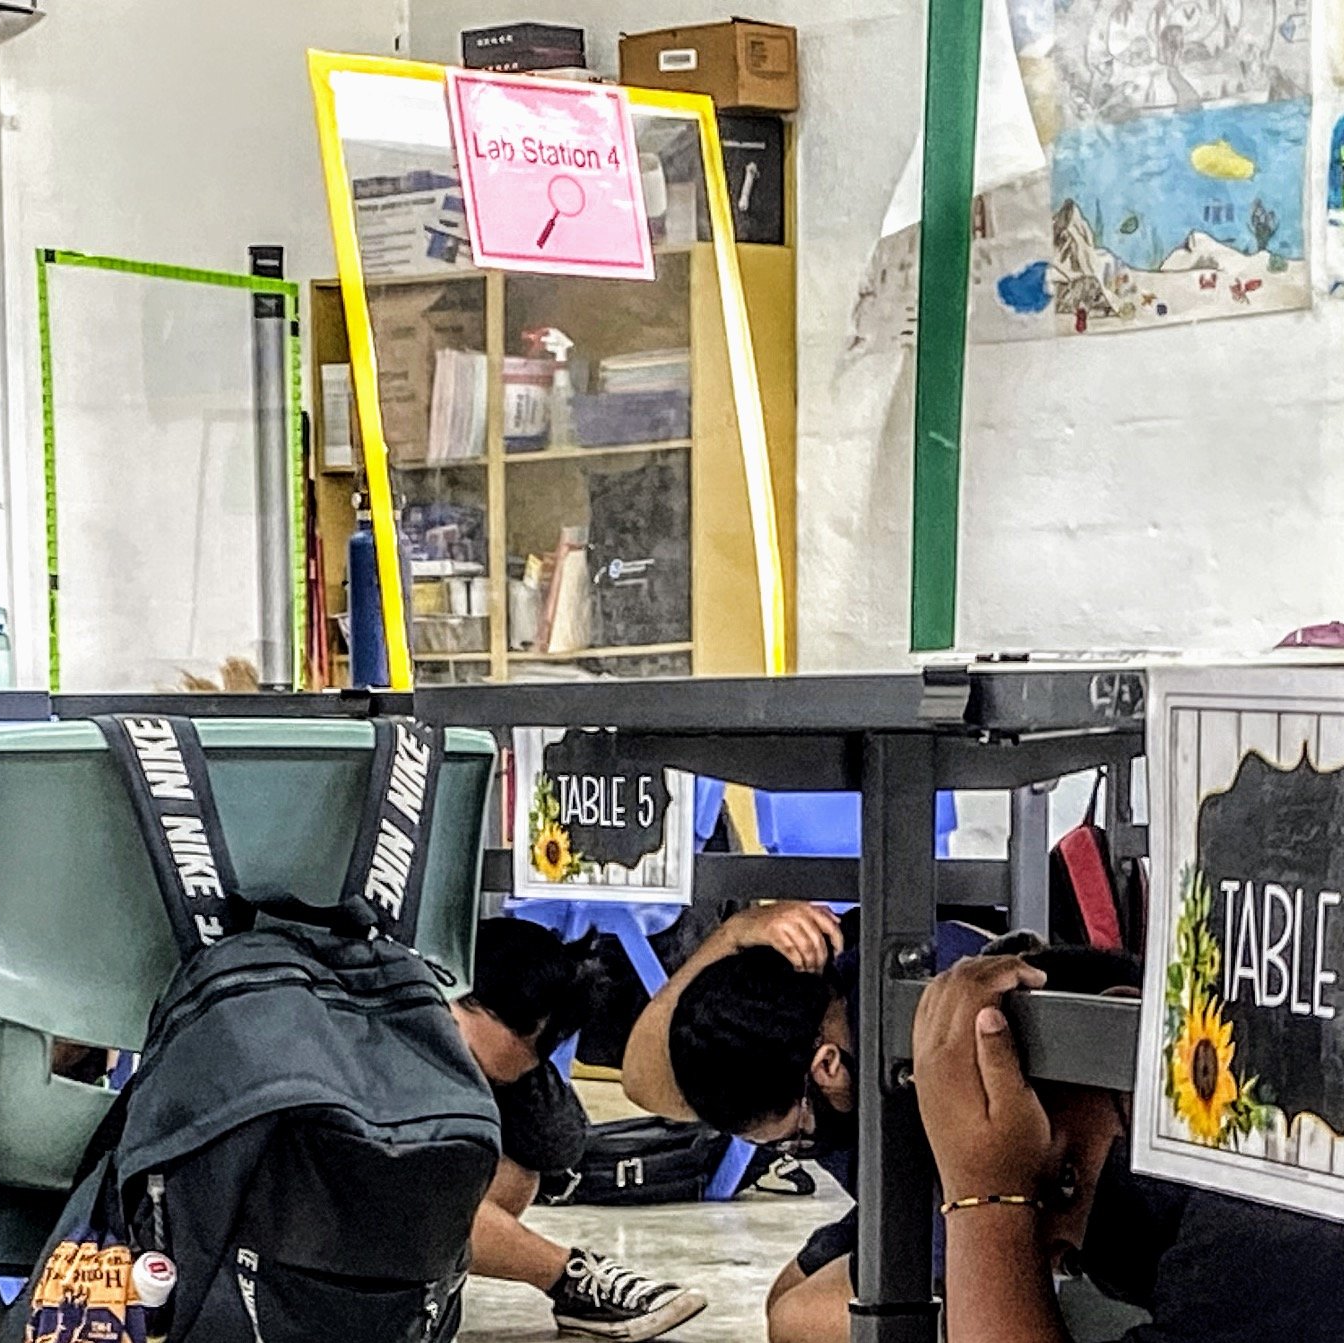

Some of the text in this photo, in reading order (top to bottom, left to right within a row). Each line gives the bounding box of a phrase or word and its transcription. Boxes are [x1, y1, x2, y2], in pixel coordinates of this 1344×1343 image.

[473, 132, 620, 172] Lab Station 4
[123, 718, 194, 800] NIKE
[387, 724, 430, 825] NIKE
[557, 775, 654, 828] TABLE 5
[160, 816, 226, 899] NIKE
[364, 819, 414, 921] NIKE
[1221, 880, 1341, 1019] TABLE
